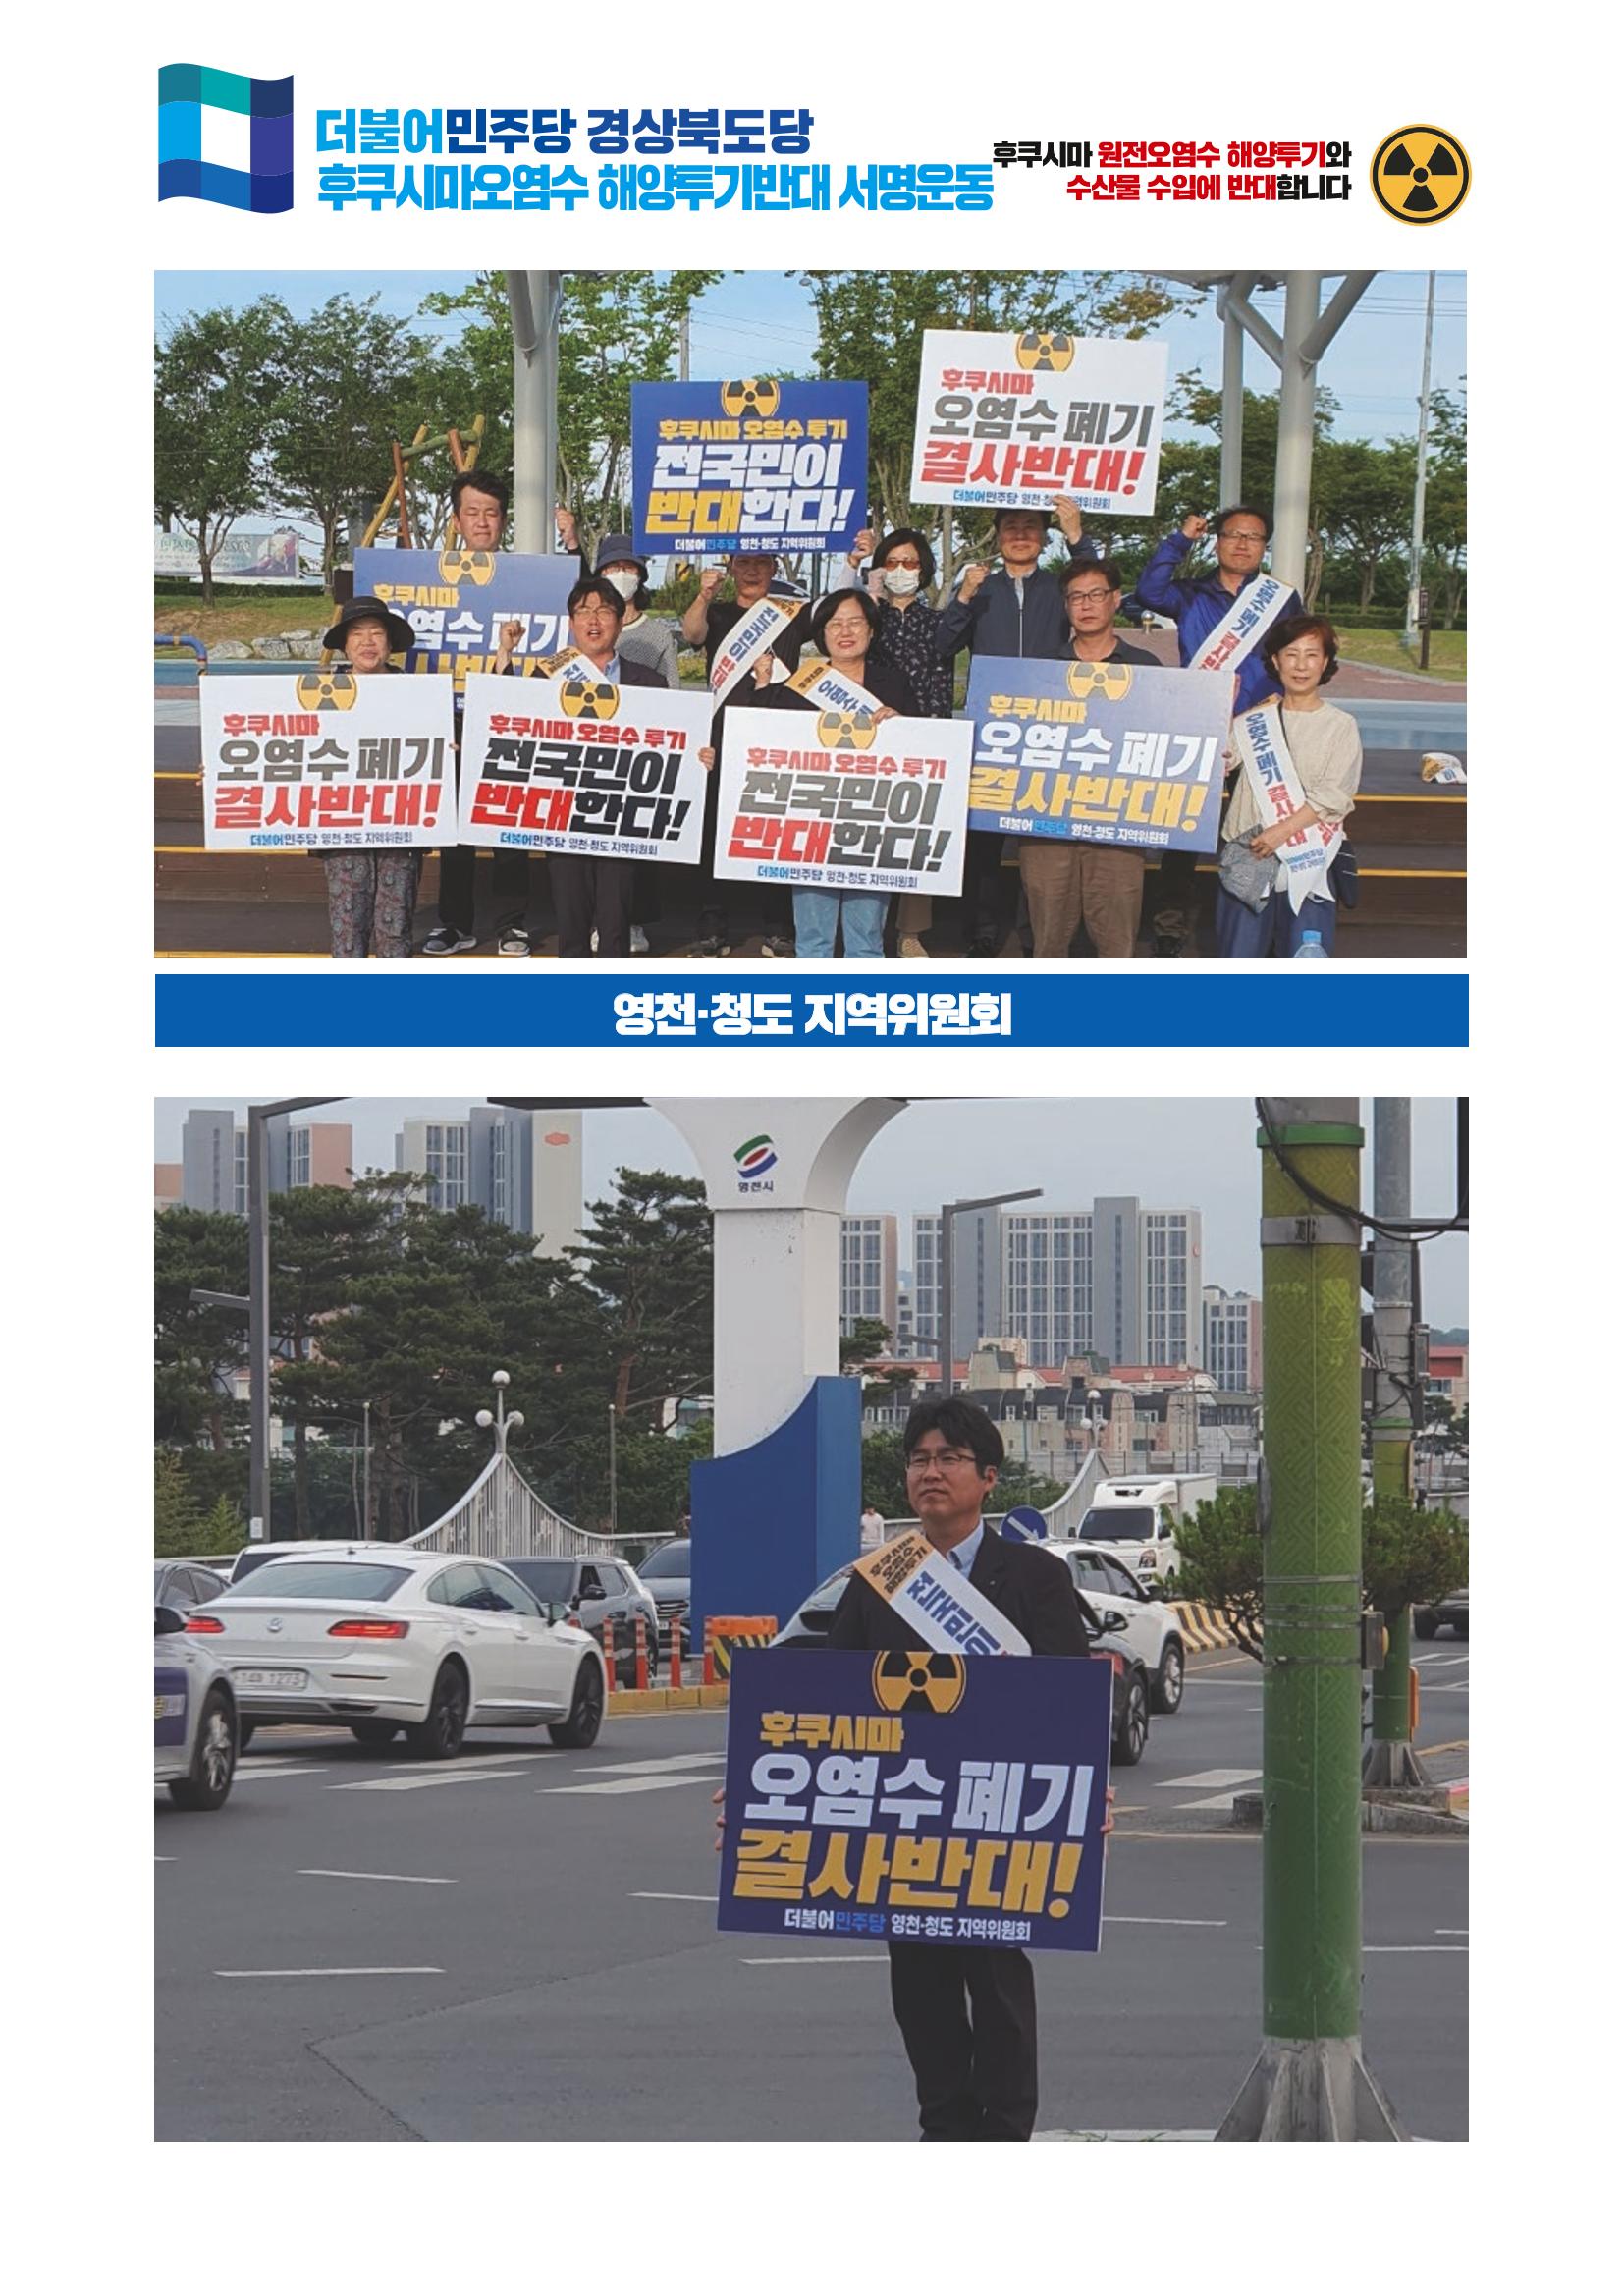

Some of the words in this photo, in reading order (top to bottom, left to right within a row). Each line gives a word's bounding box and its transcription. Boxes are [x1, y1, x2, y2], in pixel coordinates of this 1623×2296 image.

[941, 369, 1034, 395] 후쿠시마
[659, 419, 740, 440] 후쿠시마
[743, 419, 804, 440] 오염수
[807, 419, 848, 440] 투기
[929, 395, 1058, 442] 오염수
[1063, 401, 1155, 447] 폐기
[652, 443, 843, 489] 전국민이
[920, 441, 1147, 495] 결사반대!
[645, 489, 856, 534] 반대한다!
[373, 584, 460, 608] 후쿠시마
[1249, 579, 1280, 613] 오염수
[729, 606, 779, 662] 전국민이
[1231, 608, 1260, 638] 폐기
[224, 714, 320, 736] 후쿠시마
[988, 694, 1088, 724] 후쿠시마
[489, 714, 574, 740] 후쿠시마
[577, 723, 640, 746] 오염수
[644, 728, 687, 749] 투기
[974, 721, 1113, 771] 오염수
[1117, 731, 1218, 782] 폐기
[1246, 712, 1271, 752] 오염수
[217, 738, 349, 782] 오염수
[356, 738, 445, 780] 폐기
[481, 738, 682, 795] 전국민이
[747, 747, 832, 772] 후쿠시마
[835, 754, 898, 776] 오염수
[902, 757, 947, 779] 투기
[1255, 751, 1283, 786] 폐기
[214, 784, 444, 828] 결사반대!
[470, 782, 691, 841] 반대한다!
[738, 771, 942, 825] 전국민이
[969, 766, 1208, 832] 결사반대!
[728, 816, 952, 872] 반대한다!
[906, 1570, 1001, 1656] 전국민이
[760, 1710, 904, 1753] 후쿠시마
[744, 1753, 946, 1829] 오염수
[952, 1761, 1094, 1836] 폐기
[732, 1828, 1083, 1918] 결사반대!
[784, 1909, 885, 1934] 더불어민주당
[957, 1917, 1031, 1941] 지역위원회
